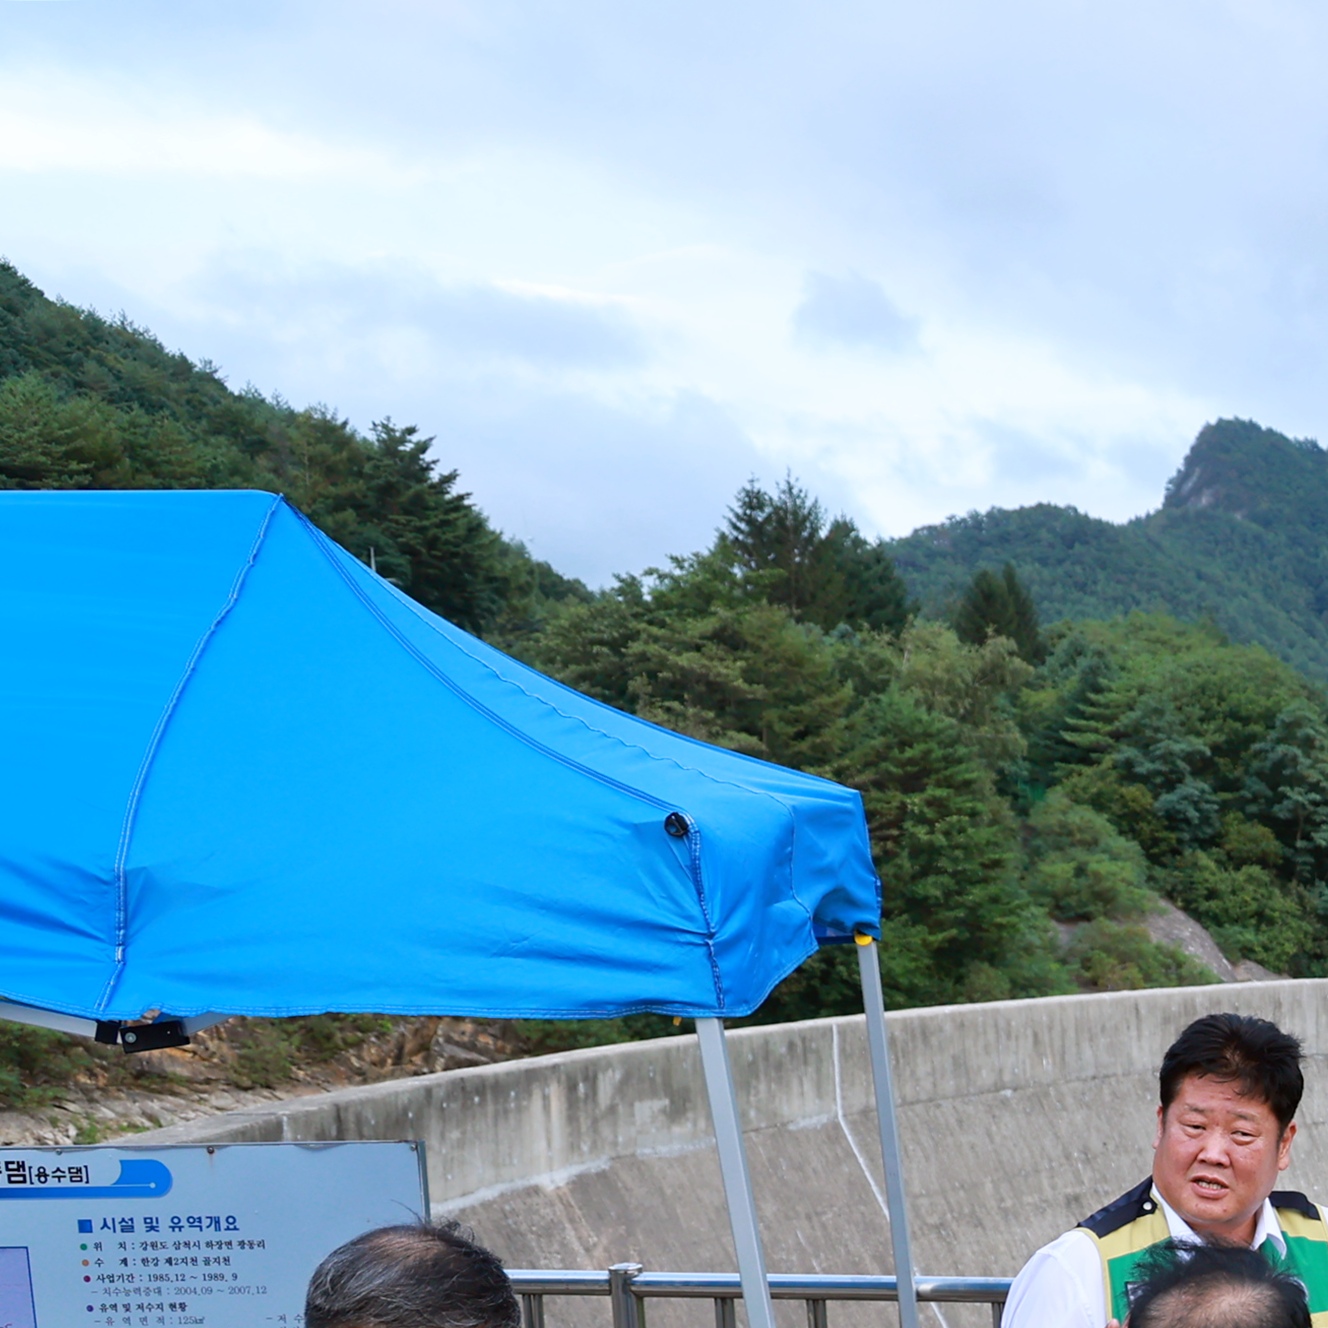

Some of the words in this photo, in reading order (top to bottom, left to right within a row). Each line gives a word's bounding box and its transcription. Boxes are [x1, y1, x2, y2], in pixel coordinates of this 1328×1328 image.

[0, 1160, 90, 1184] 댐[용수댐]
[100, 1216, 136, 1233] 시설
[143, 1216, 161, 1233] 및
[168, 1215, 240, 1233] 유역개요
[139, 1240, 169, 1251] 강원도
[172, 1240, 201, 1250] 삼척시
[205, 1239, 234, 1250] 하장면
[236, 1239, 266, 1250] 광동리
[140, 1257, 160, 1267] 한강
[164, 1256, 199, 1267] 제2지천
[201, 1256, 232, 1266] 골지천
[96, 1273, 136, 1283] 사업기간
[147, 1273, 186, 1284] 1985.12
[102, 1286, 163, 1297] 치수능력증대
[173, 1286, 213, 1296] 2004.09
[227, 1286, 268, 1296] 2007.12
[99, 1303, 120, 1313] 유역
[122, 1303, 132, 1312] 및
[135, 1302, 165, 1312] 저수지
[168, 1302, 188, 1312] 현황
